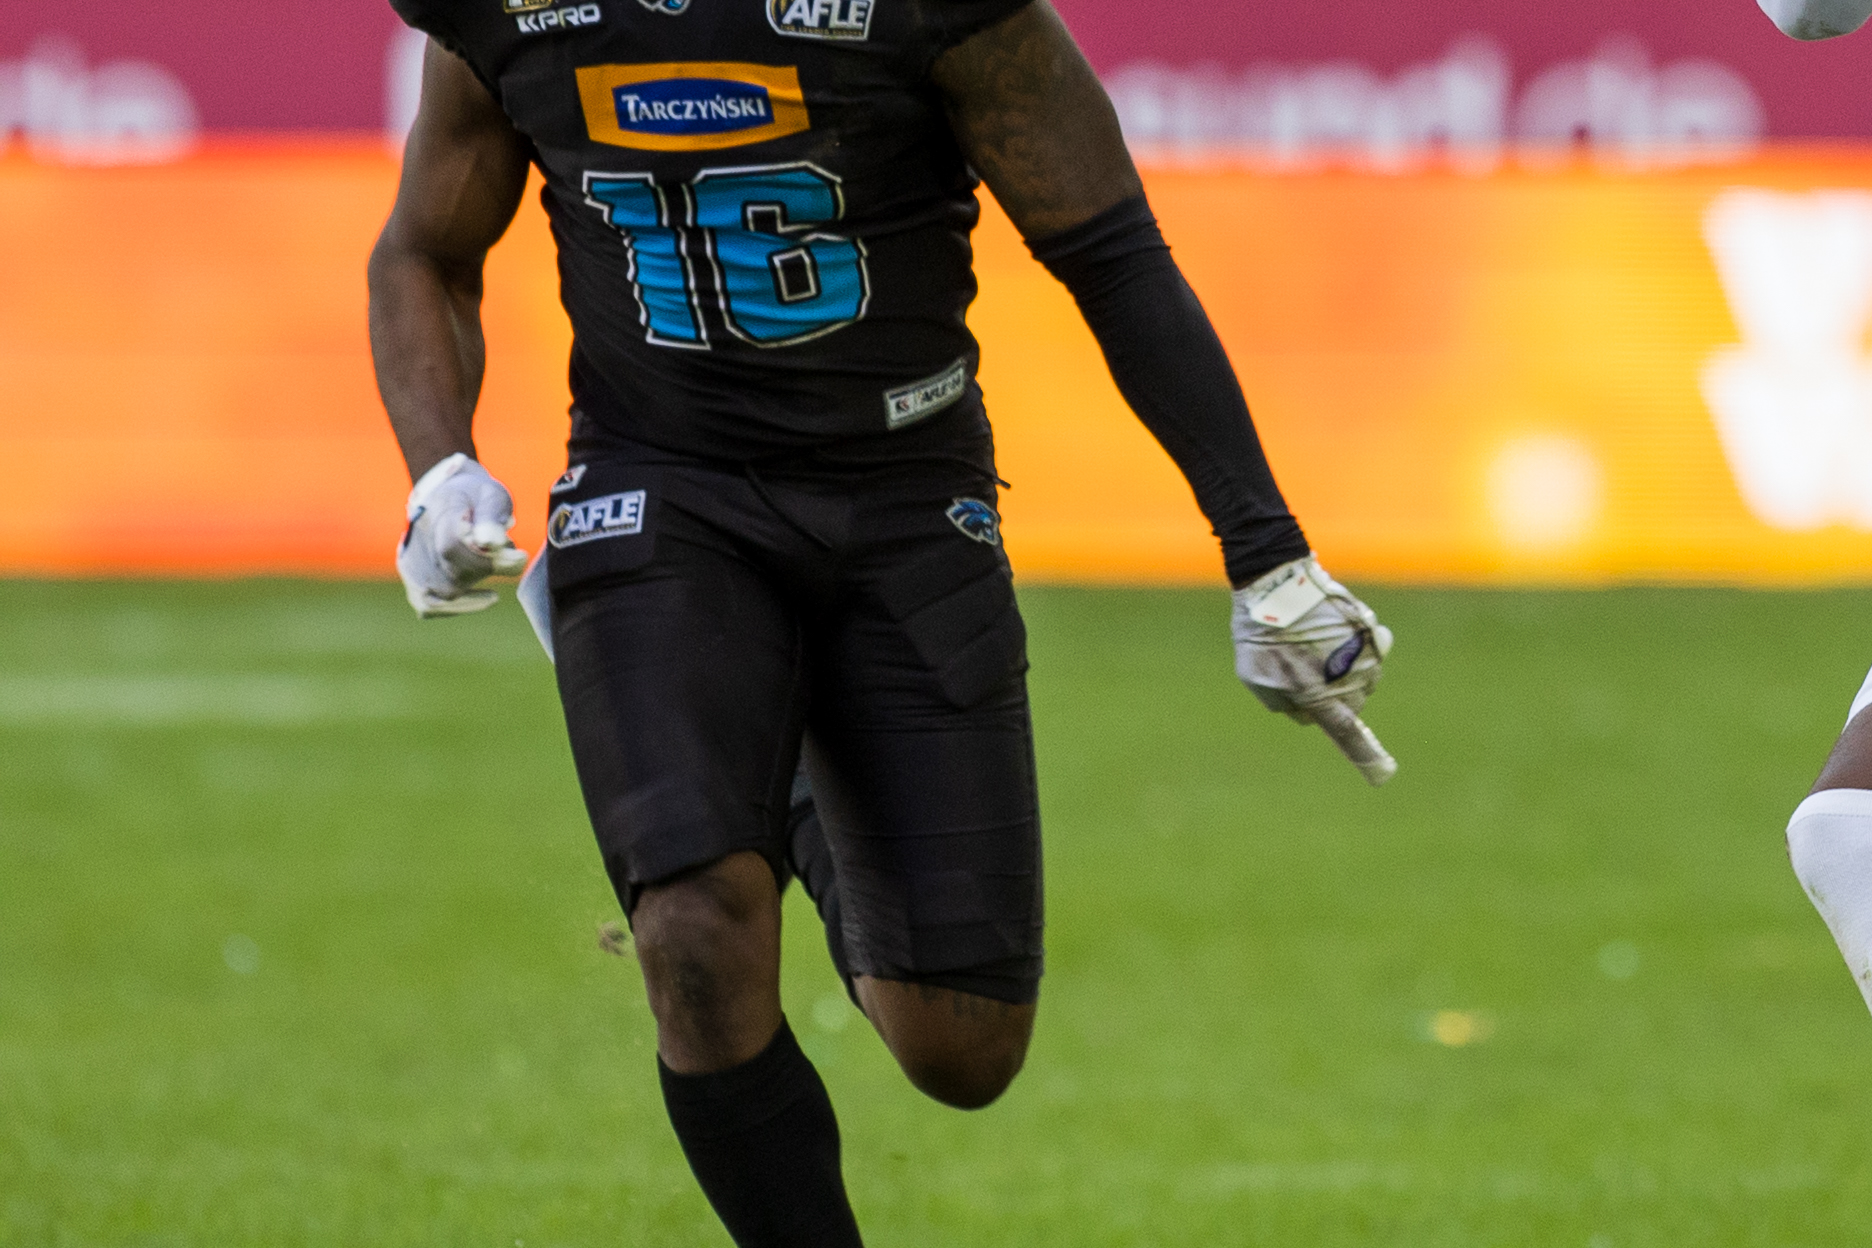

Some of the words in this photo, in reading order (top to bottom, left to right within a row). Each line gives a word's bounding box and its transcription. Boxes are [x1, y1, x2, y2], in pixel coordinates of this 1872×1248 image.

[516, 3, 600, 33] KPRO
[621, 93, 766, 123] TARCZYŃSKI
[582, 161, 869, 350] 16
[561, 496, 639, 537] AFLE
